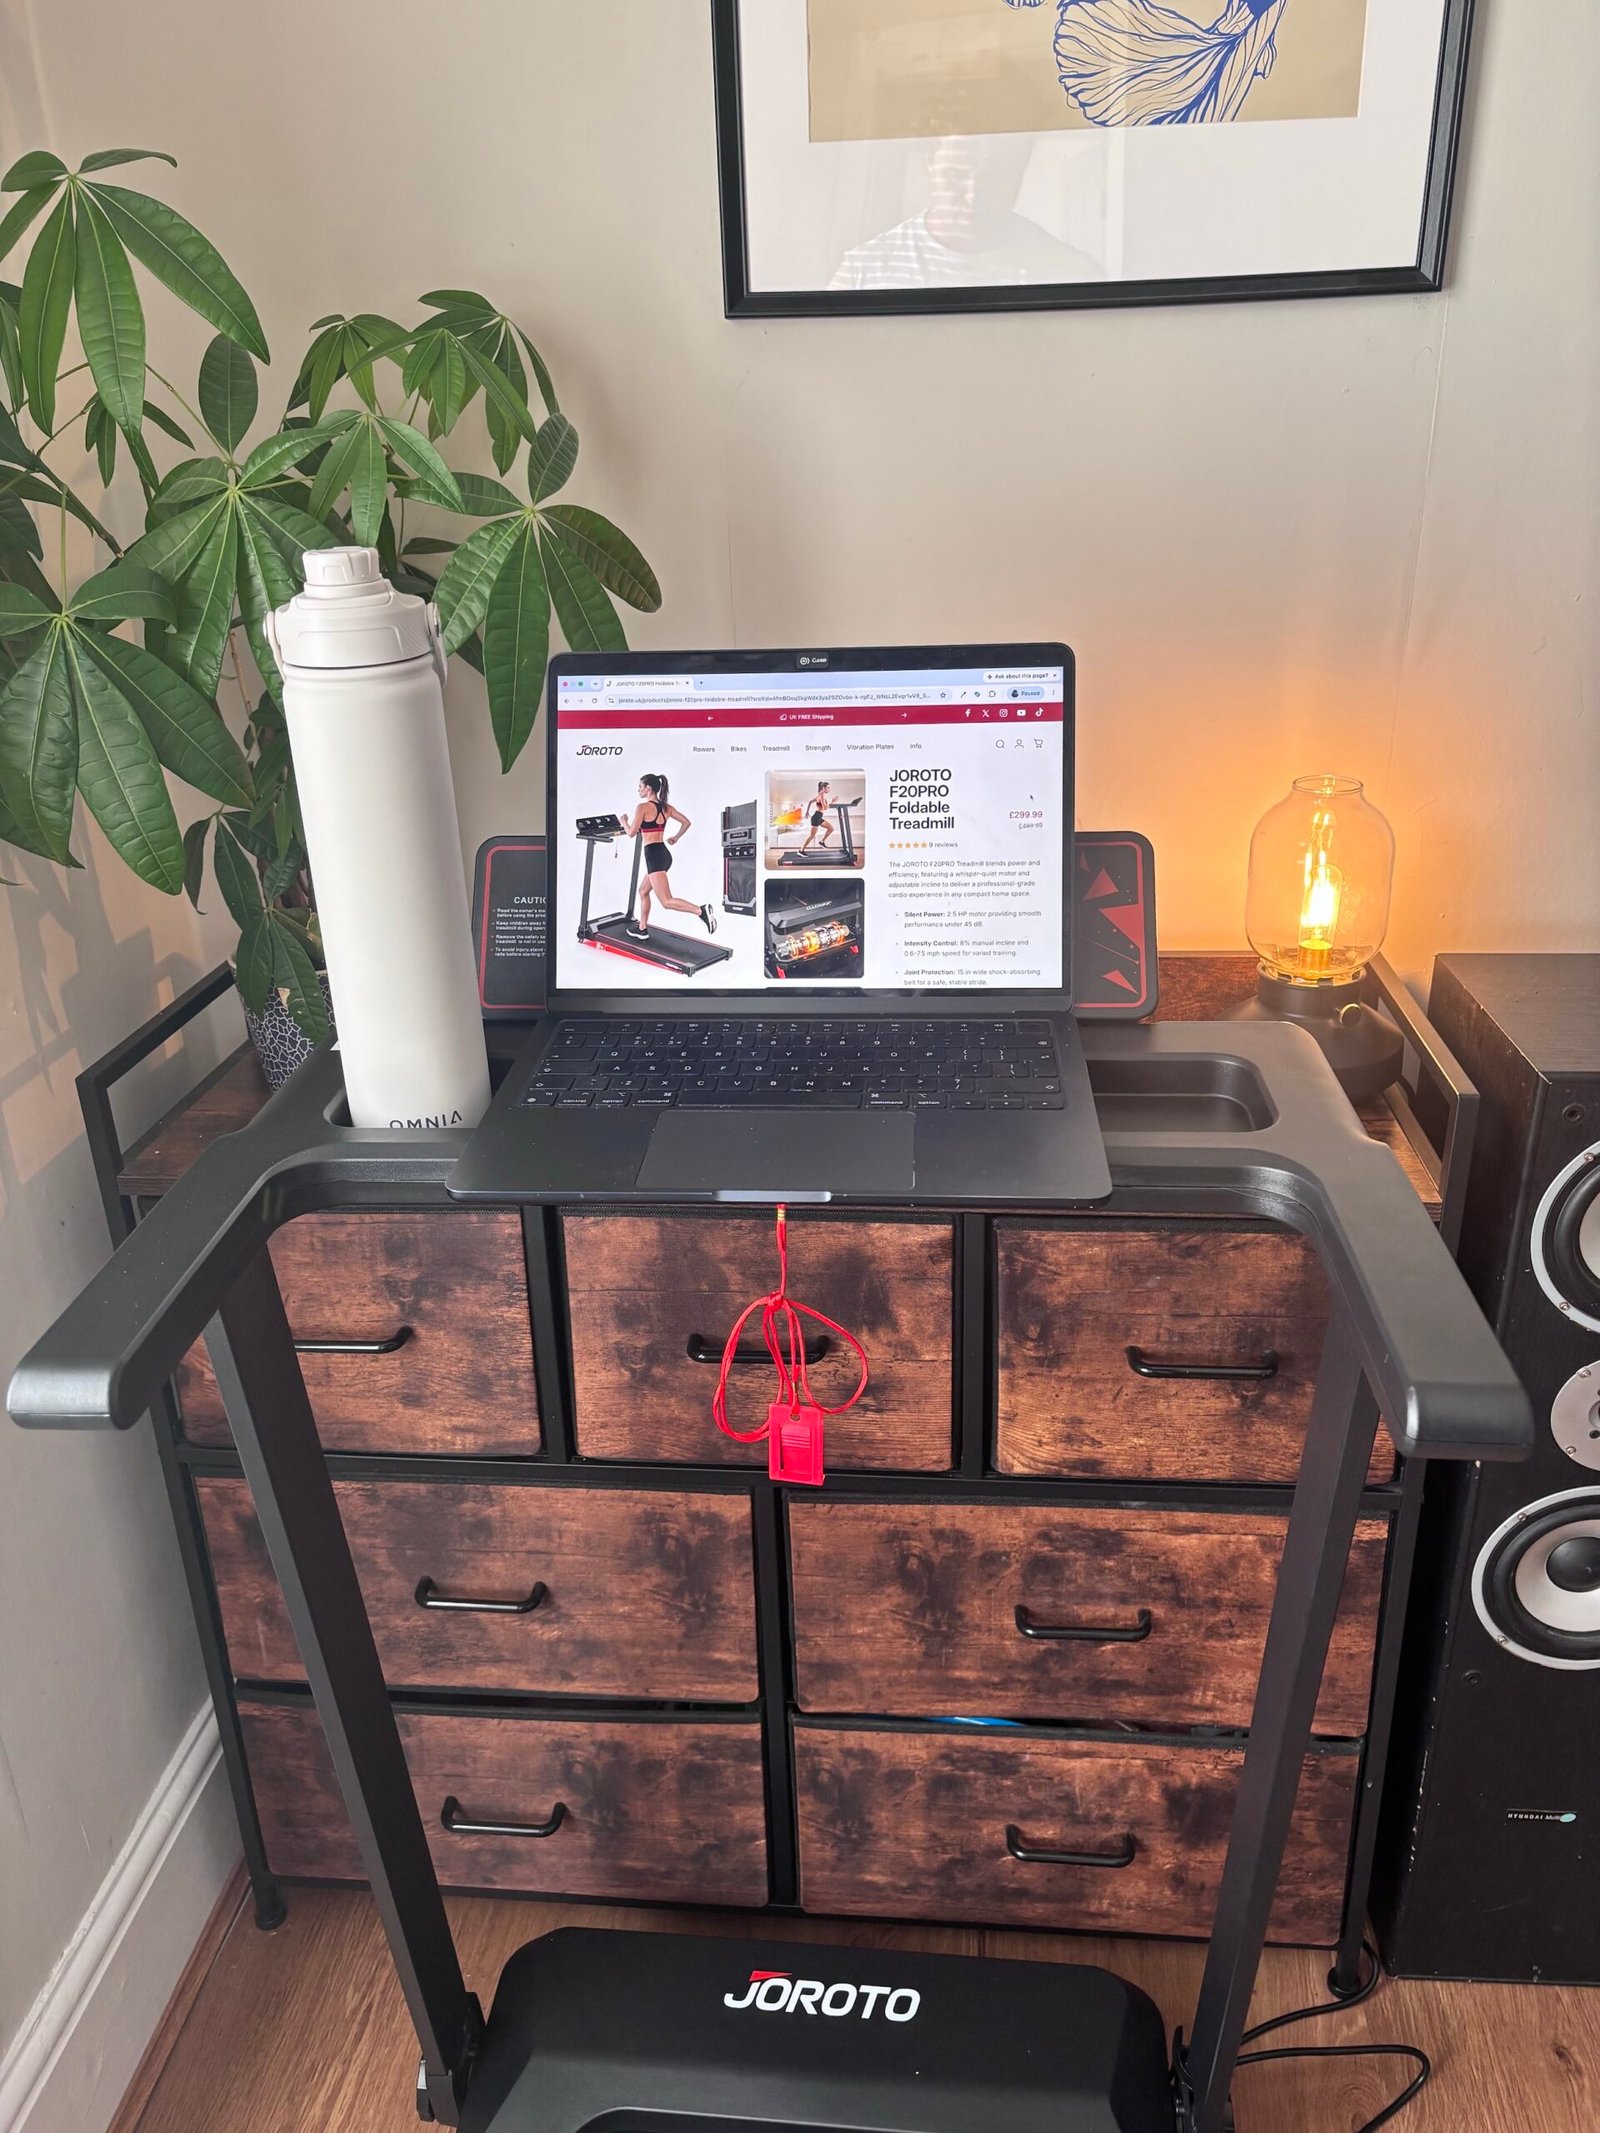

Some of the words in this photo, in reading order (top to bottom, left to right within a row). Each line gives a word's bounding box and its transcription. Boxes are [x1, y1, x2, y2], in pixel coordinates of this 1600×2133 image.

[576, 744, 623, 756] JOROTO
[805, 744, 831, 752] Strength
[890, 769, 952, 782] JOROTO
[890, 785, 949, 798] F20PRO
[890, 801, 950, 814] Foldable
[1009, 811, 1043, 819] £299.99
[889, 817, 955, 829] Treadmill
[955, 870, 997, 878] whisper-quiet
[904, 940, 931, 948] Intensity
[390, 1110, 462, 1128] OMNIA
[724, 1970, 920, 2022] JOROTO
